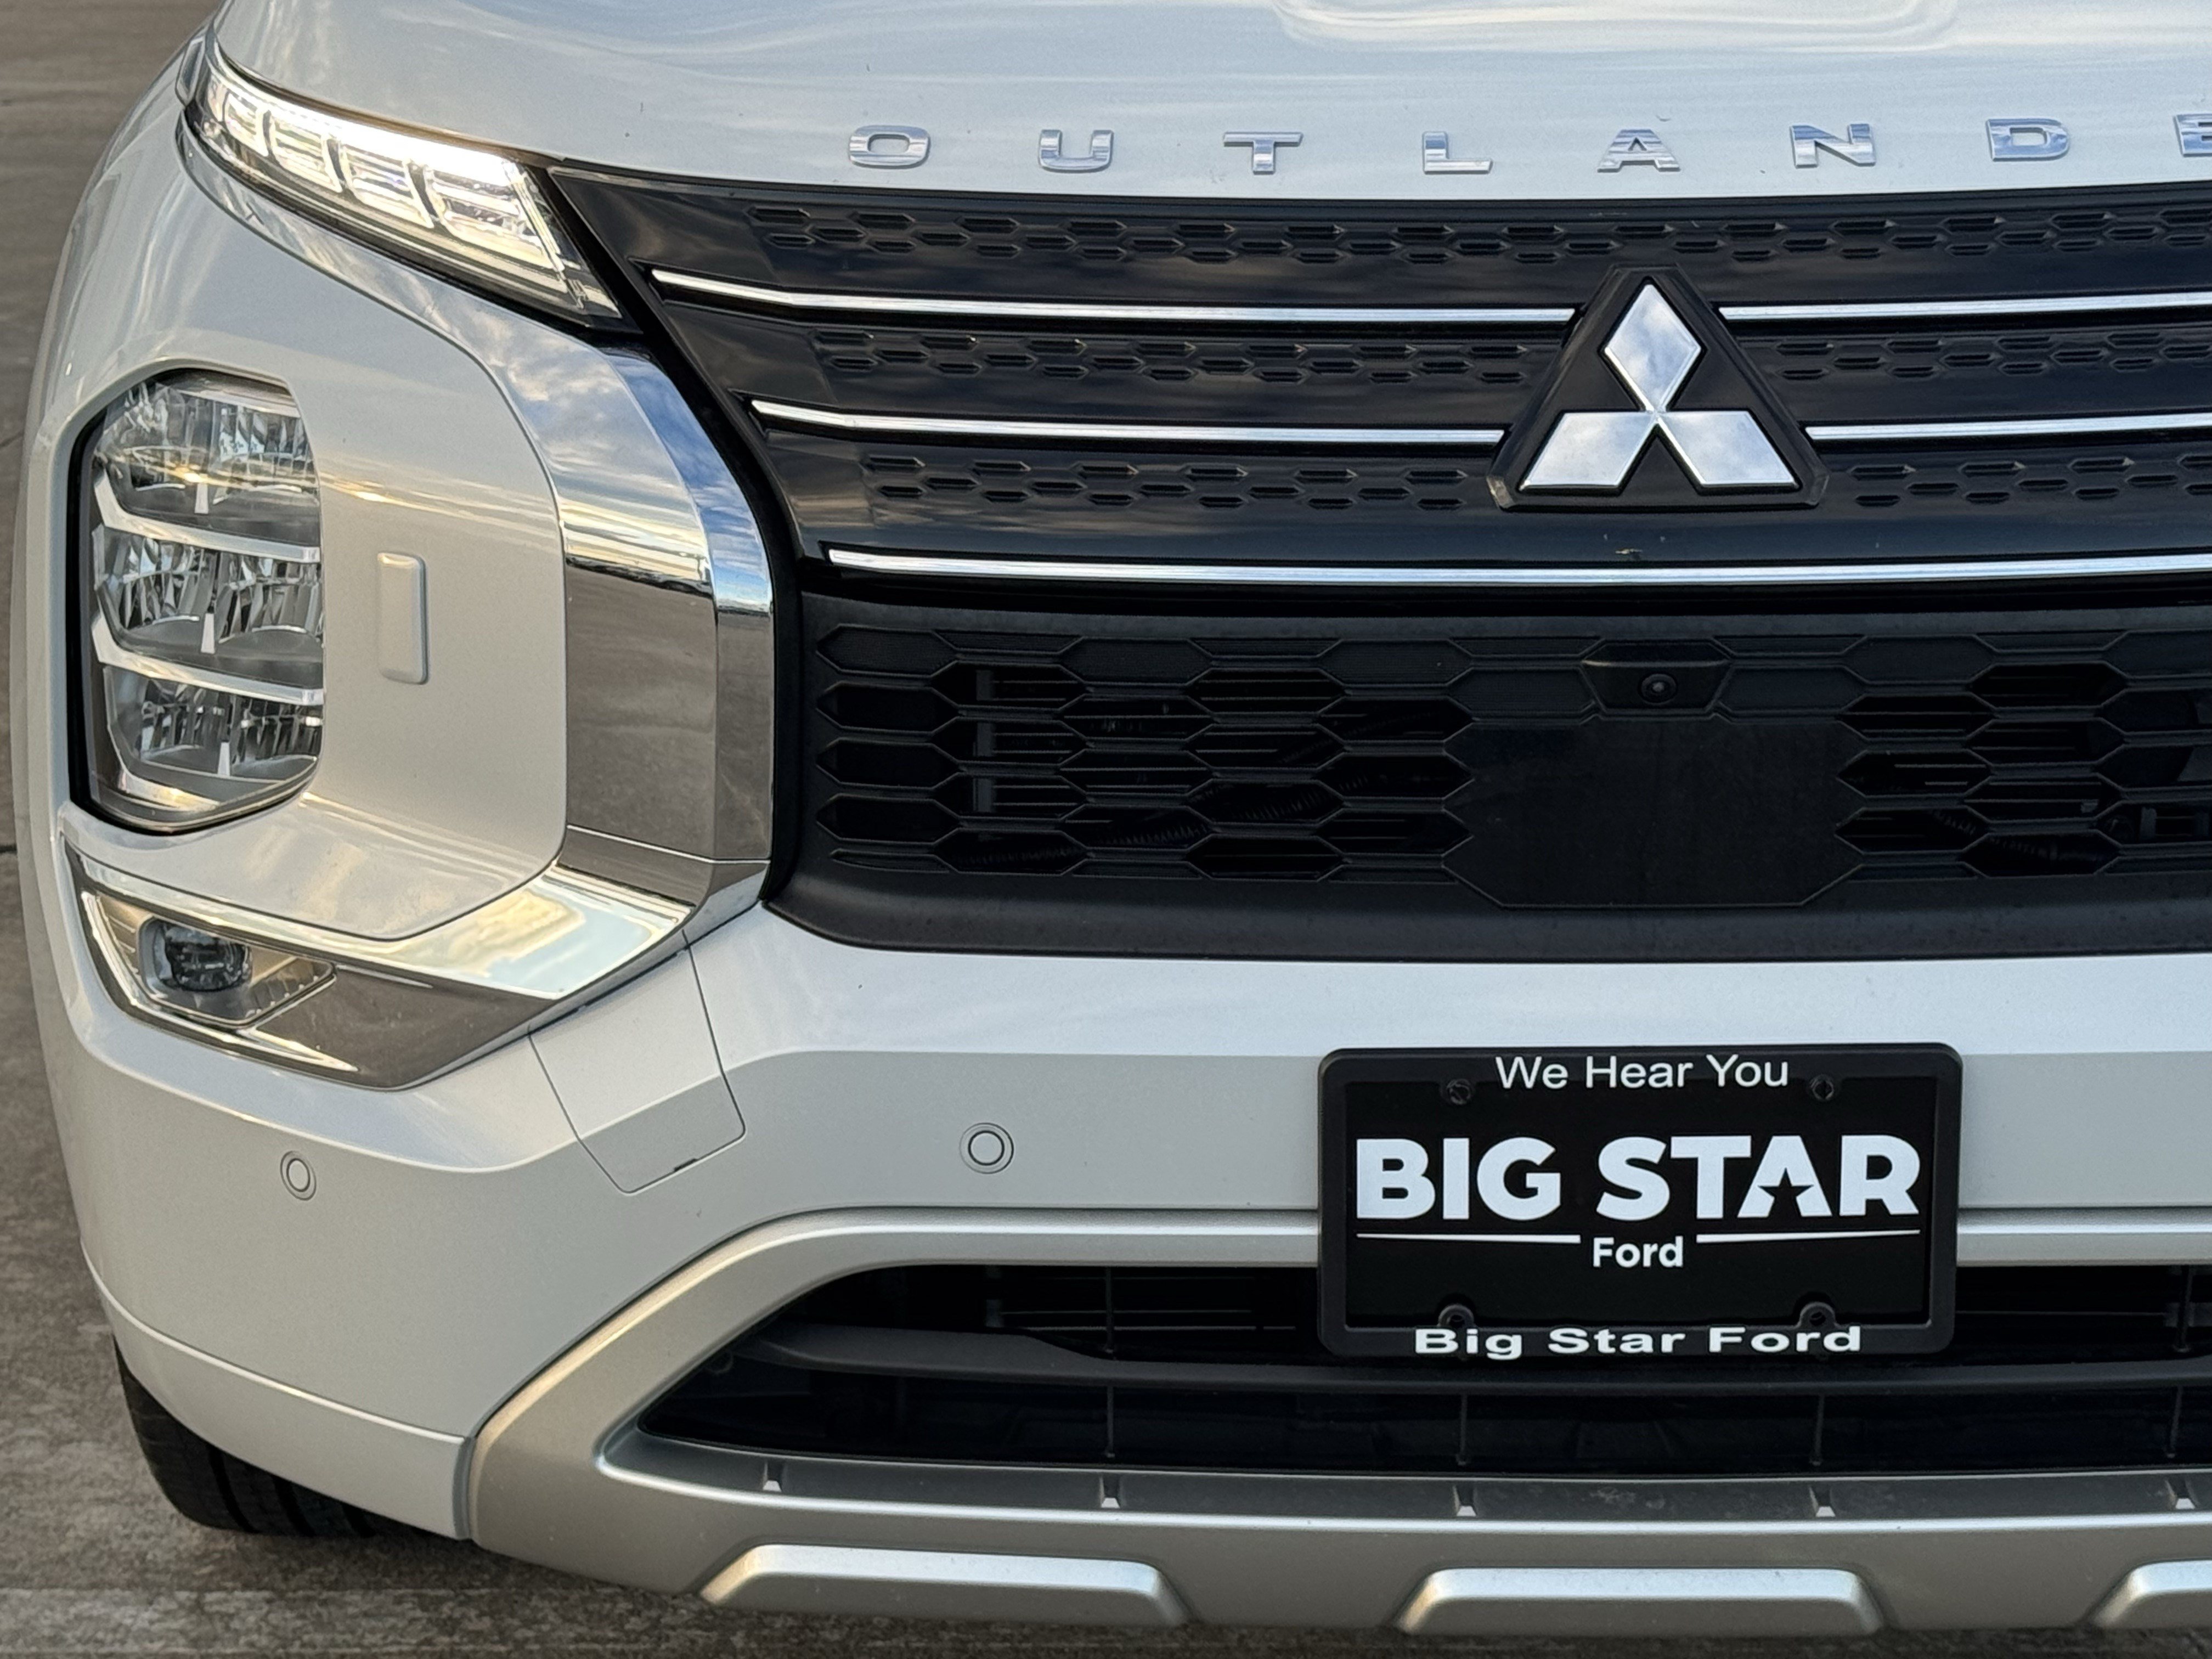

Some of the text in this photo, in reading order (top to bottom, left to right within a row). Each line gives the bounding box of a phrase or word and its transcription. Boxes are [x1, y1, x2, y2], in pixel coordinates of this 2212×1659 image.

[1496, 1054, 1788, 1089] We Hear You
[1357, 1135, 1920, 1221] BIG STAR
[1593, 1236, 1683, 1267] Ford
[1415, 1326, 1860, 1360] Big Star Ford
